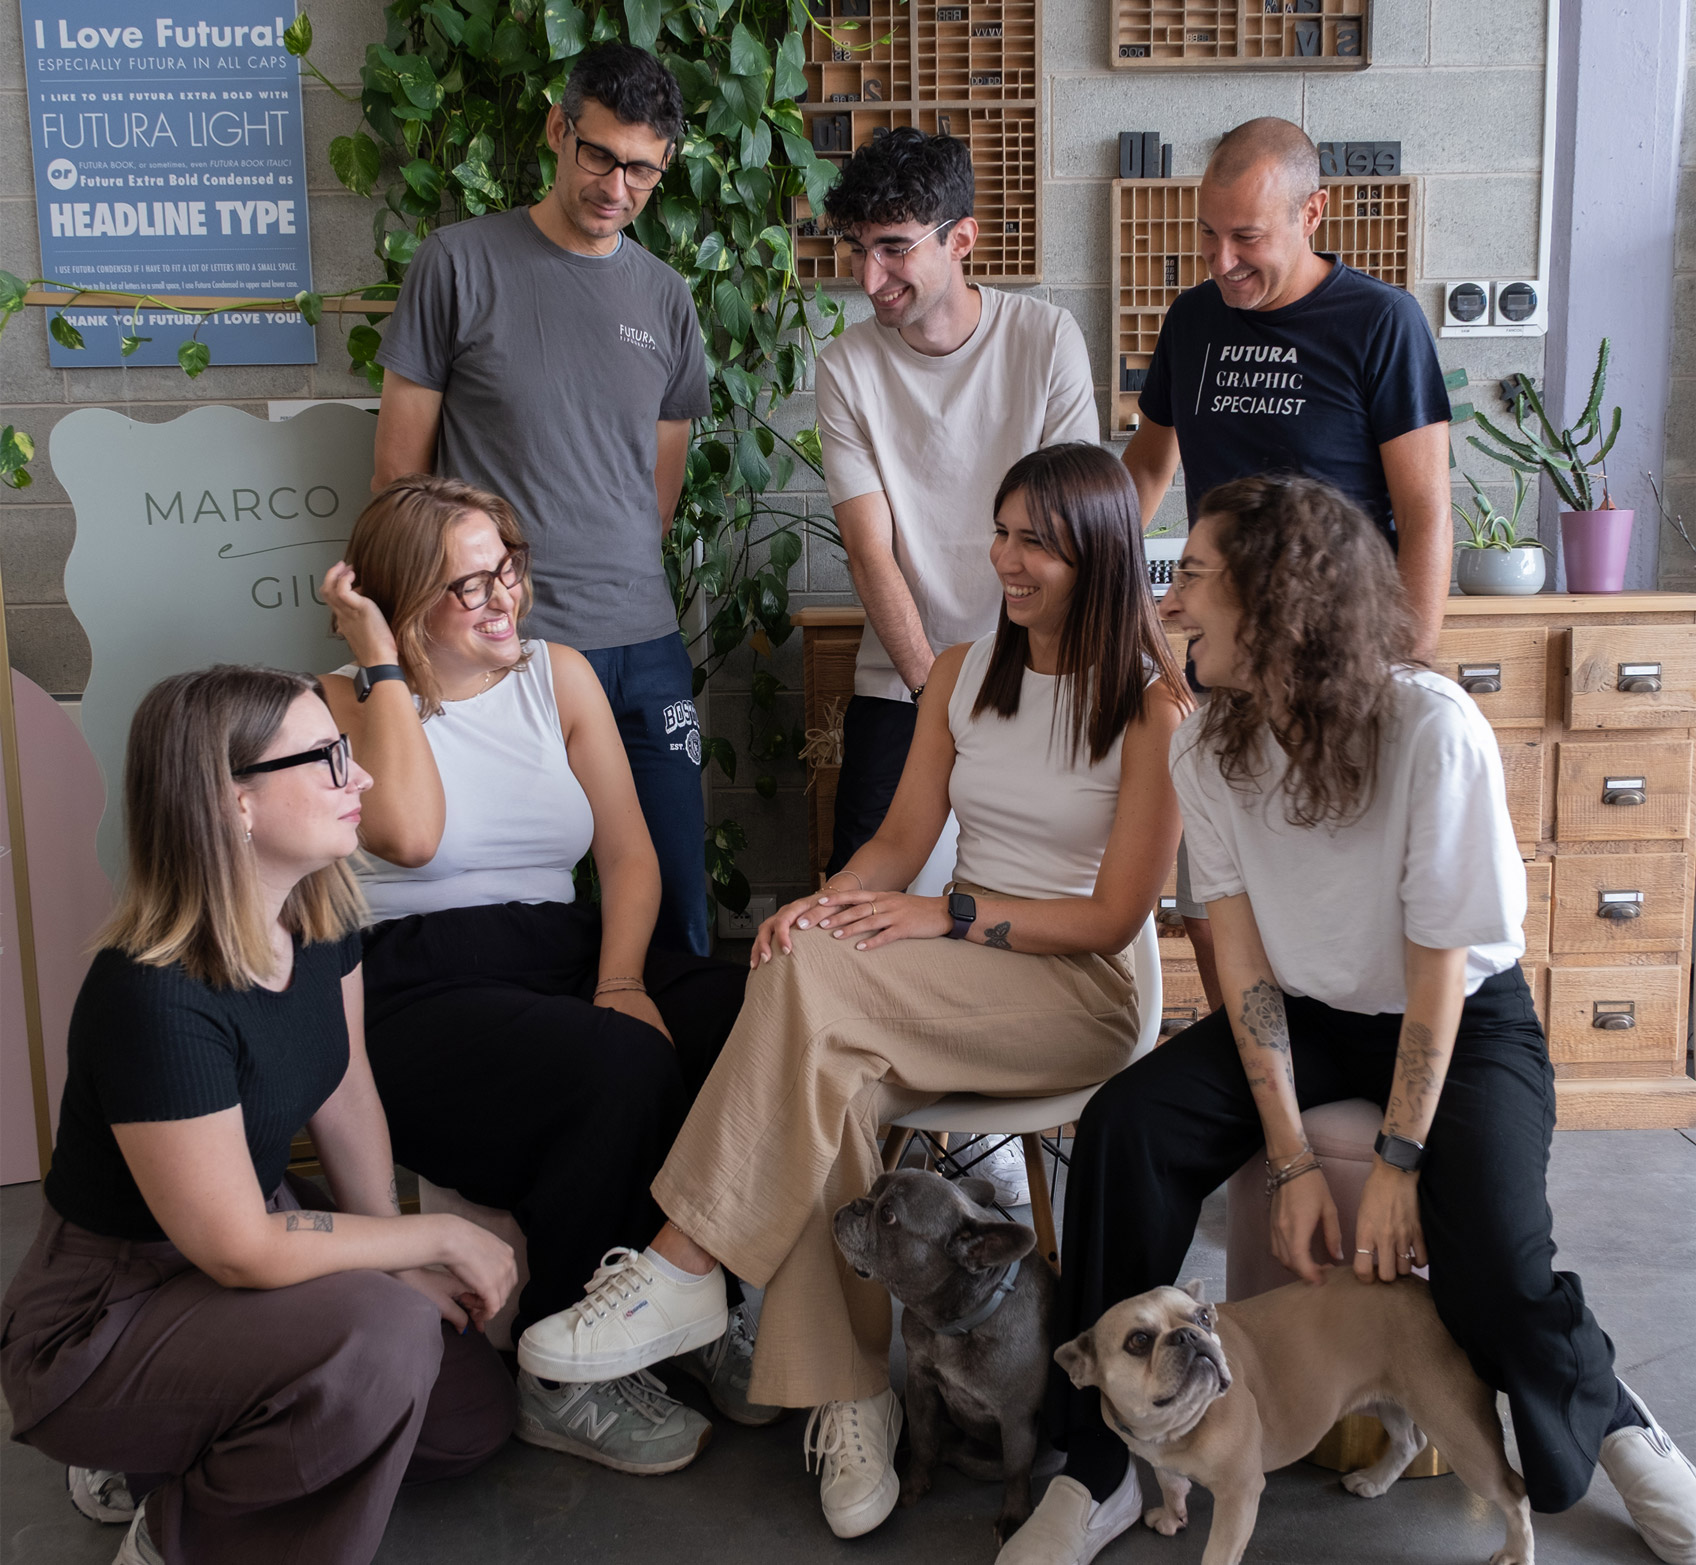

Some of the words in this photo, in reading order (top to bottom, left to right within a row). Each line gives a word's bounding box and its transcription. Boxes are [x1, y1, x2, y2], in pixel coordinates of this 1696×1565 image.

[35, 20, 44, 49] I
[58, 19, 143, 49] Love
[156, 17, 285, 48] Futura!
[38, 58, 121, 71] ESPECIALLY
[129, 57, 186, 70] FUTURA
[193, 56, 210, 69] IN
[217, 56, 241, 69] ALL
[247, 56, 287, 69] CAPS
[51, 93, 76, 102] LIKE
[82, 93, 96, 102] TO
[102, 93, 123, 101] USE
[129, 92, 174, 101] FUTURA
[180, 91, 217, 100] EXTRA
[222, 91, 253, 99] BOLD
[259, 90, 289, 99] WITH
[42, 112, 178, 148] FUTURA
[189, 111, 289, 147] LIGHT
[79, 161, 109, 169] FUTURA
[149, 161, 188, 169] sometimes,
[210, 160, 239, 168] FUTURA
[241, 160, 264, 168] BOOK
[50, 168, 72, 180] or
[80, 175, 124, 187] Futura
[128, 174, 164, 187] Extra
[169, 173, 198, 186] Bold
[203, 172, 274, 186] Condensed
[279, 175, 294, 185] as
[51, 202, 207, 237] HEADLINE
[216, 200, 296, 235] TYPE
[60, 265, 71, 274] USE
[72, 265, 95, 274] FUTURA
[96, 264, 132, 273] CONDENSED
[133, 264, 140, 273] IF
[145, 264, 161, 273] HAVE
[162, 264, 171, 272] TO
[172, 264, 181, 272] FIT
[182, 264, 187, 272] A
[188, 264, 200, 272] LOT
[201, 263, 209, 272] OF
[210, 263, 234, 272] LETTERS
[235, 263, 250, 271] INTO
[251, 263, 257, 271] A
[258, 263, 277, 271] SMALL
[279, 262, 298, 271] SPACE.
[124, 282, 140, 290] letters
[152, 281, 165, 289] small
[195, 281, 212, 289] Futura
[212, 280, 239, 289] Condensed
[261, 280, 271, 288] and
[271, 280, 285, 288] lower
[113, 315, 144, 326] YOU
[214, 314, 219, 325] I
[224, 313, 260, 324] LOVE
[265, 312, 302, 324] YOU!
[620, 324, 656, 345] FUTURA
[1220, 345, 1298, 363] FUTURA
[1216, 371, 1303, 390] GRAPHIC
[1210, 395, 1306, 416] SPECIALIST
[145, 485, 340, 525] MARCO
[670, 743, 685, 751] EST.
